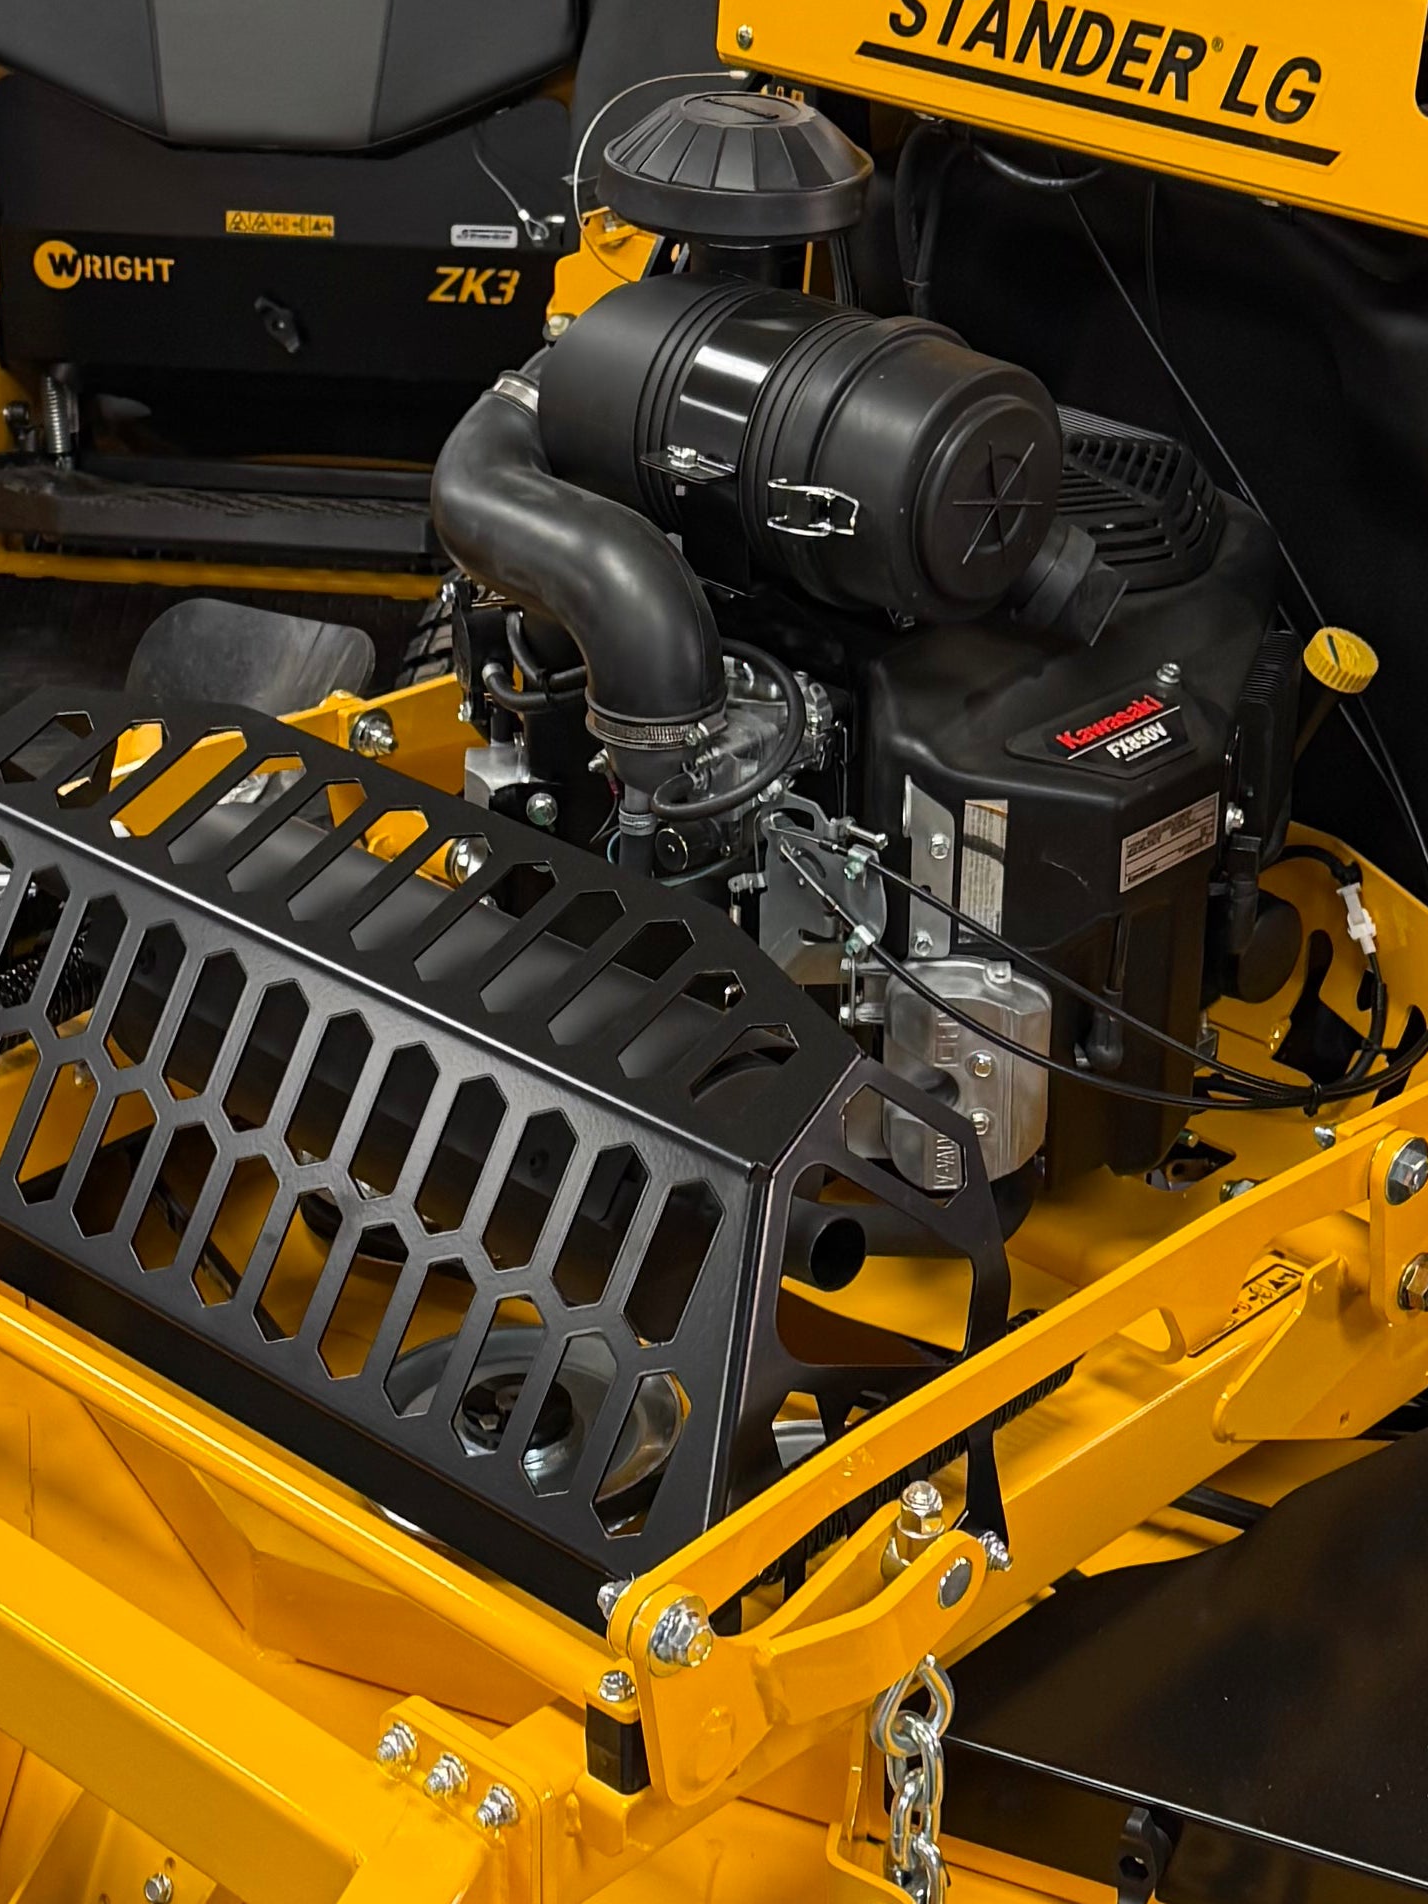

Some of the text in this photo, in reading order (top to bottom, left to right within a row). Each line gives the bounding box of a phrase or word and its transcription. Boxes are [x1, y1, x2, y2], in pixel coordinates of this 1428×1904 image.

[1220, 43, 1323, 125] LG
[42, 244, 175, 284] WRIGHT
[427, 266, 521, 306] ZK3
[1055, 694, 1164, 750] Kawasaki
[1105, 721, 1168, 759] FX850V
